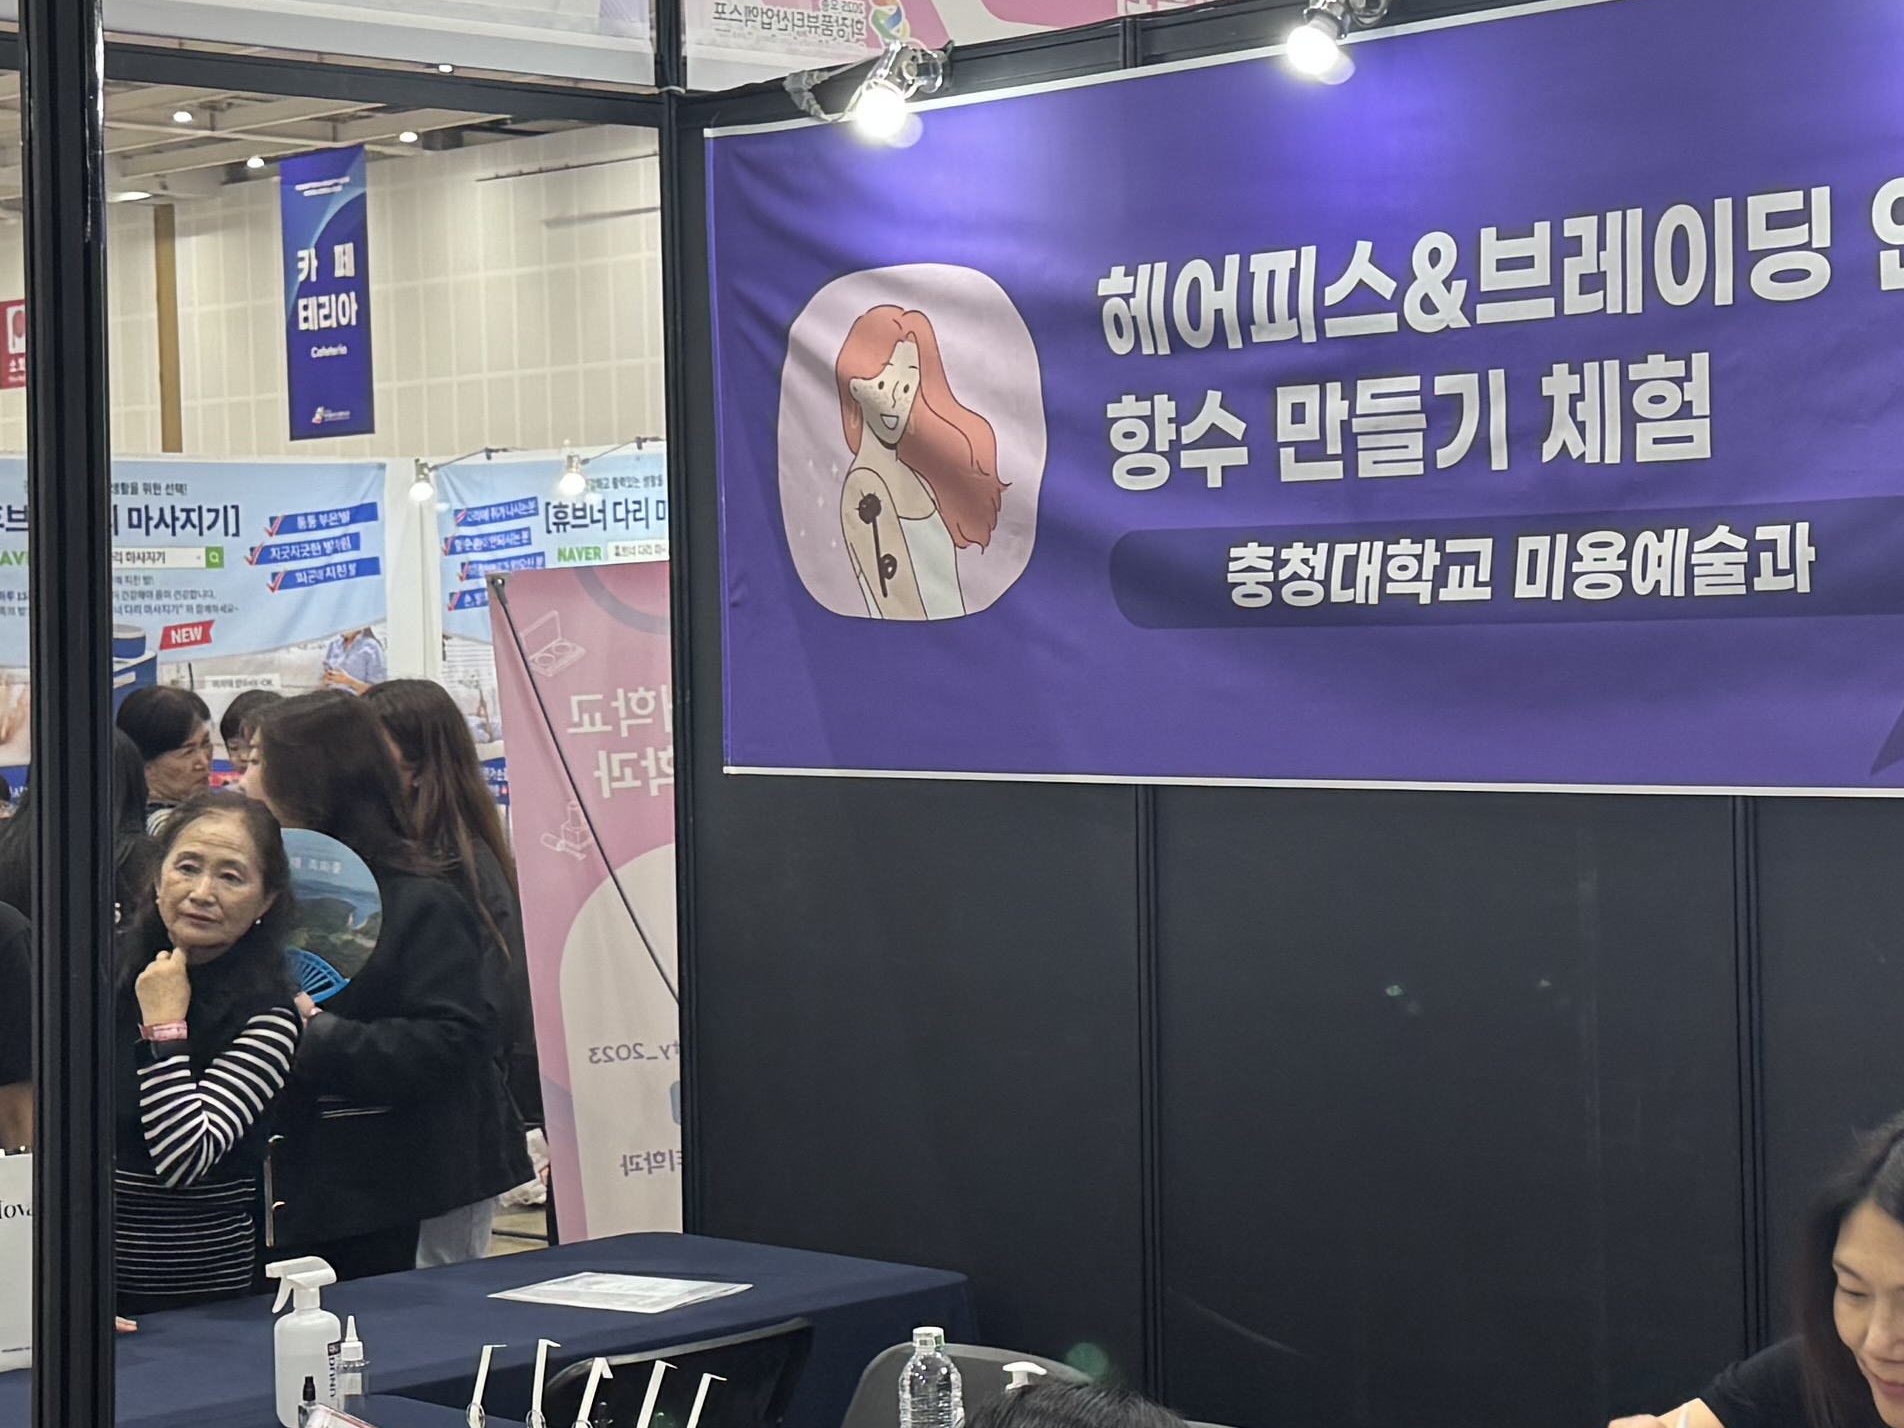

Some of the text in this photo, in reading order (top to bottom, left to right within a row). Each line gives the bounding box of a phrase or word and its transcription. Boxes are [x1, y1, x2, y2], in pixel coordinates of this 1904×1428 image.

[1097, 185, 1831, 357] 헤어피스&브레이딩
[297, 291, 358, 331] 테리아
[1106, 351, 1712, 491] 향수 만들기 체험
[128, 504, 241, 537] 마사지기]
[545, 497, 649, 535] [휴브너 다리
[125, 551, 166, 564] 마사지기
[557, 546, 602, 562] NAVER
[1226, 523, 1816, 610] 충청대학교 미용예술과
[170, 627, 203, 645] NEW
